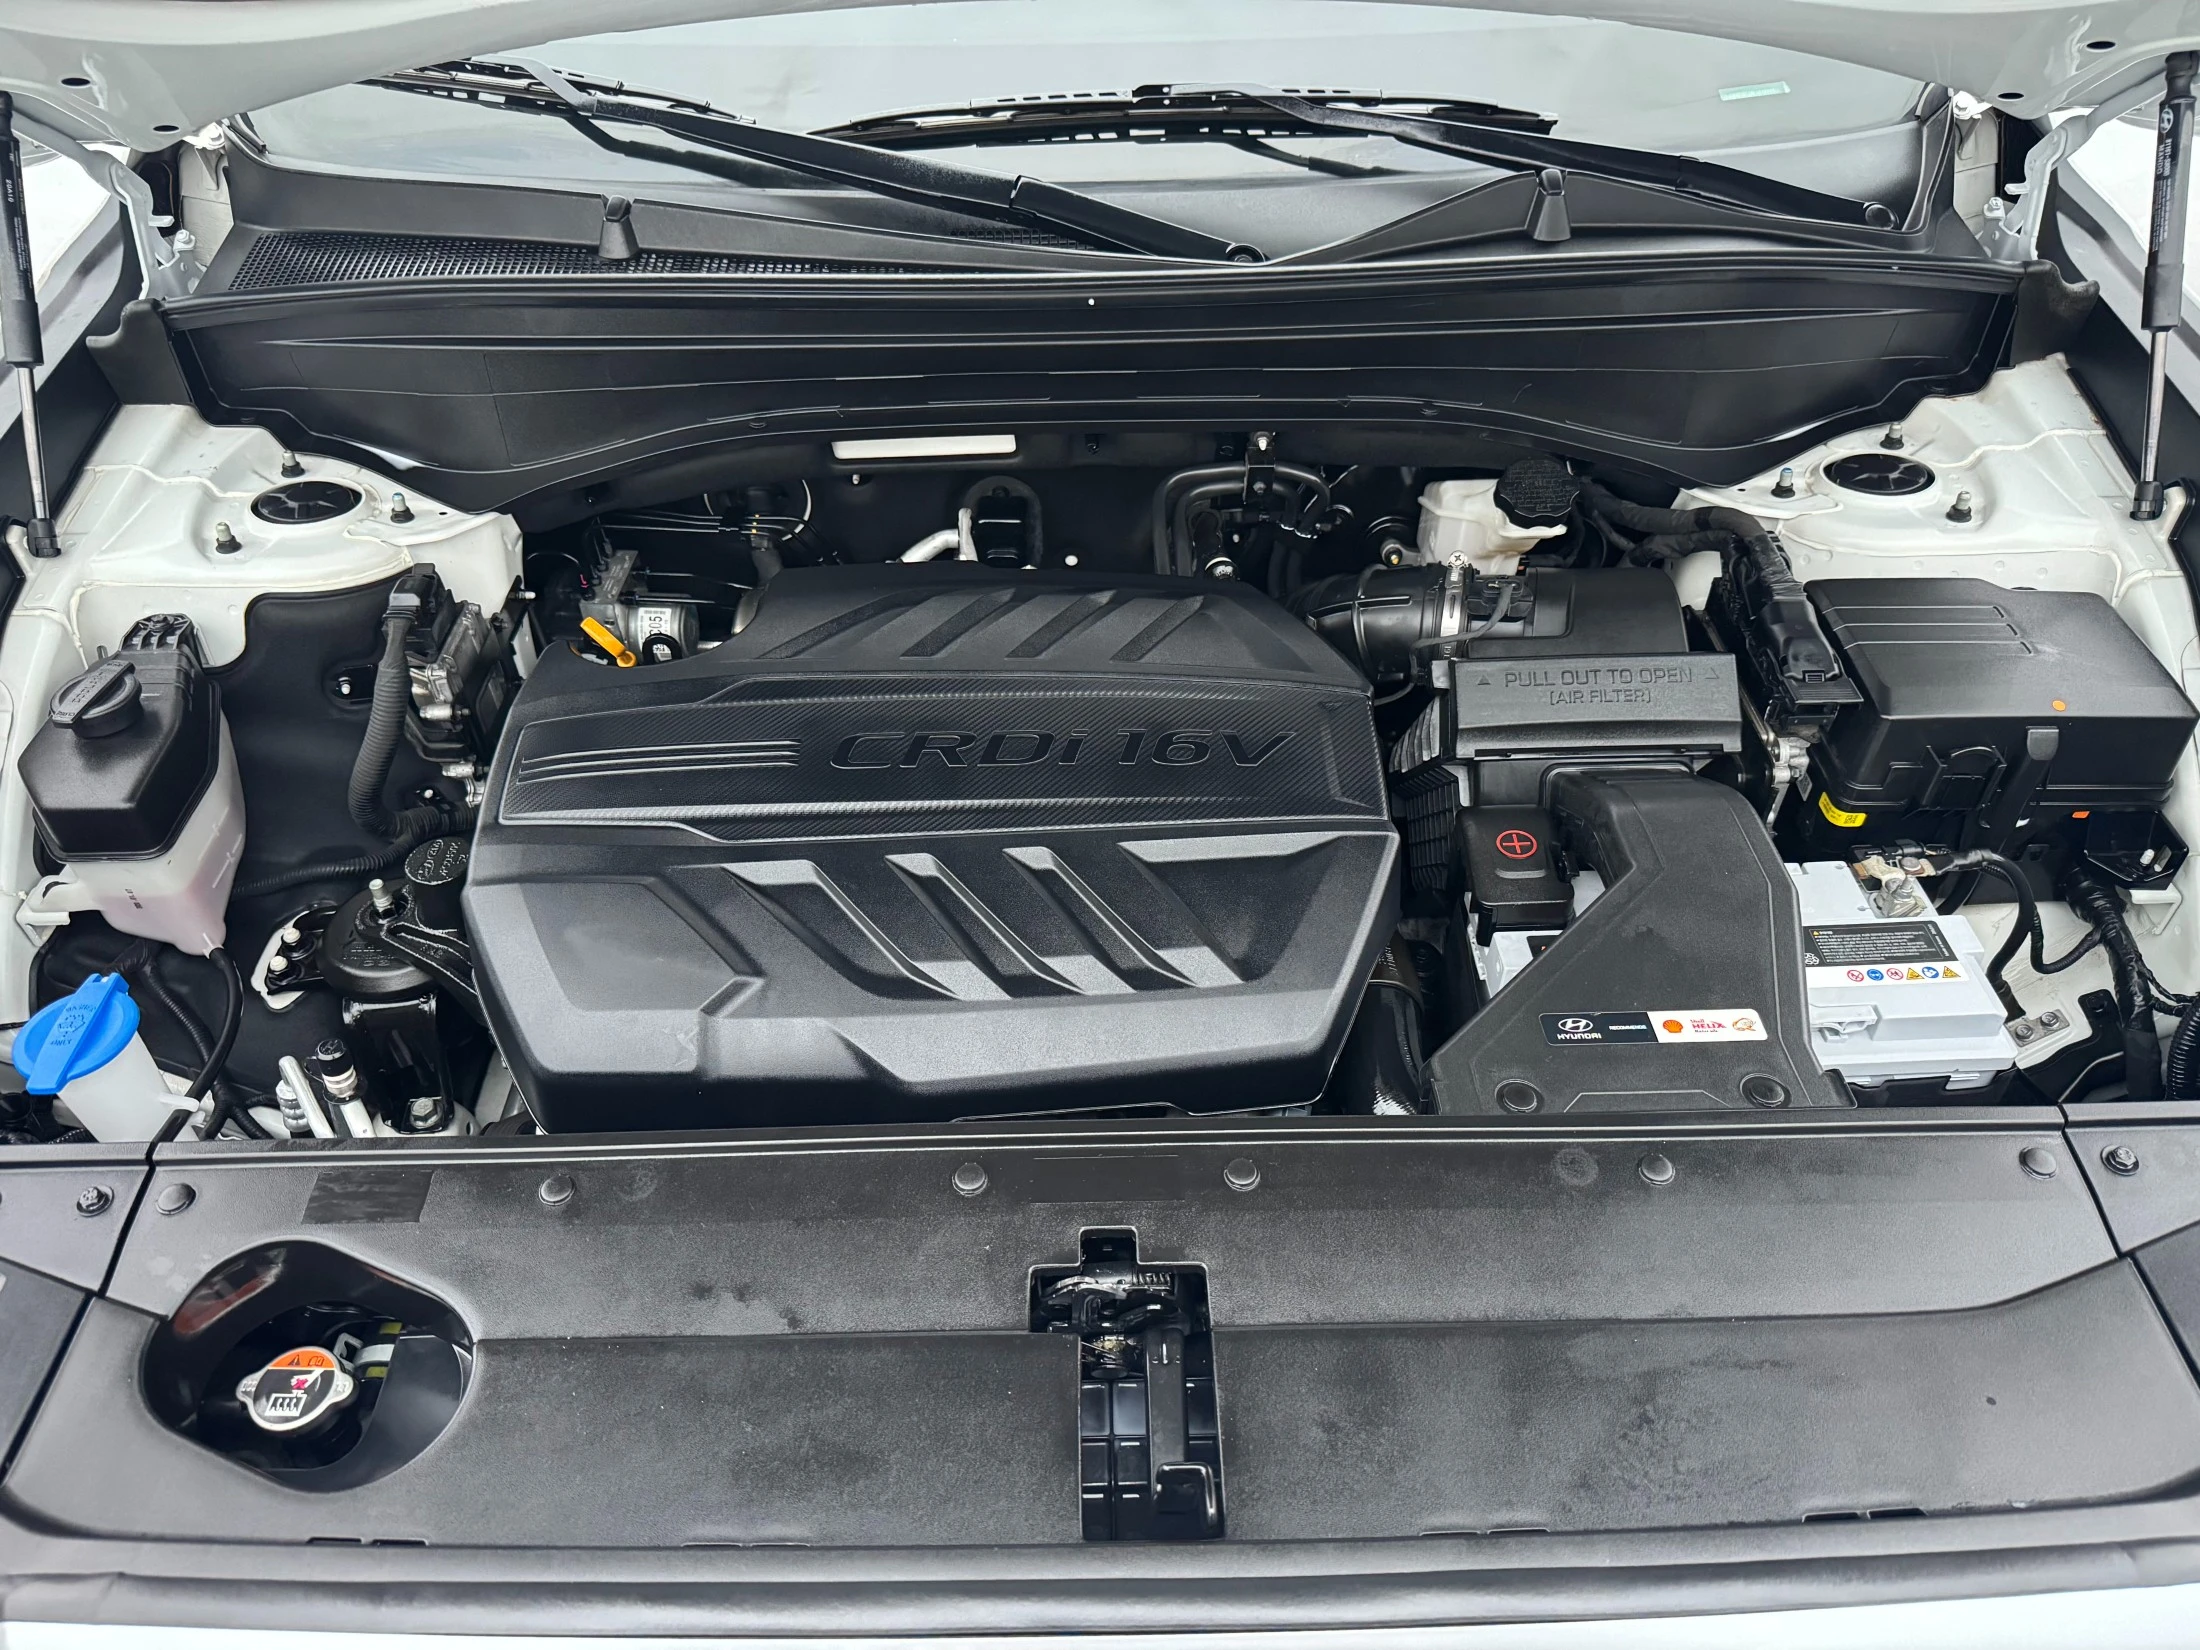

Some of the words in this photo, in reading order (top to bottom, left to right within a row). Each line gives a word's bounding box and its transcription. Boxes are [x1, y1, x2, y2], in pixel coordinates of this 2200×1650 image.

[1504, 671, 1556, 688] PULL
[1561, 669, 1602, 686] OUT
[1606, 668, 1633, 684] TO
[1638, 667, 1693, 684] OPEN
[830, 728, 1090, 770] CRDi
[1117, 727, 1296, 768] 16V
[1692, 1021, 1727, 1029] HELIX
[1557, 1032, 1602, 1040] HYUNDAI
